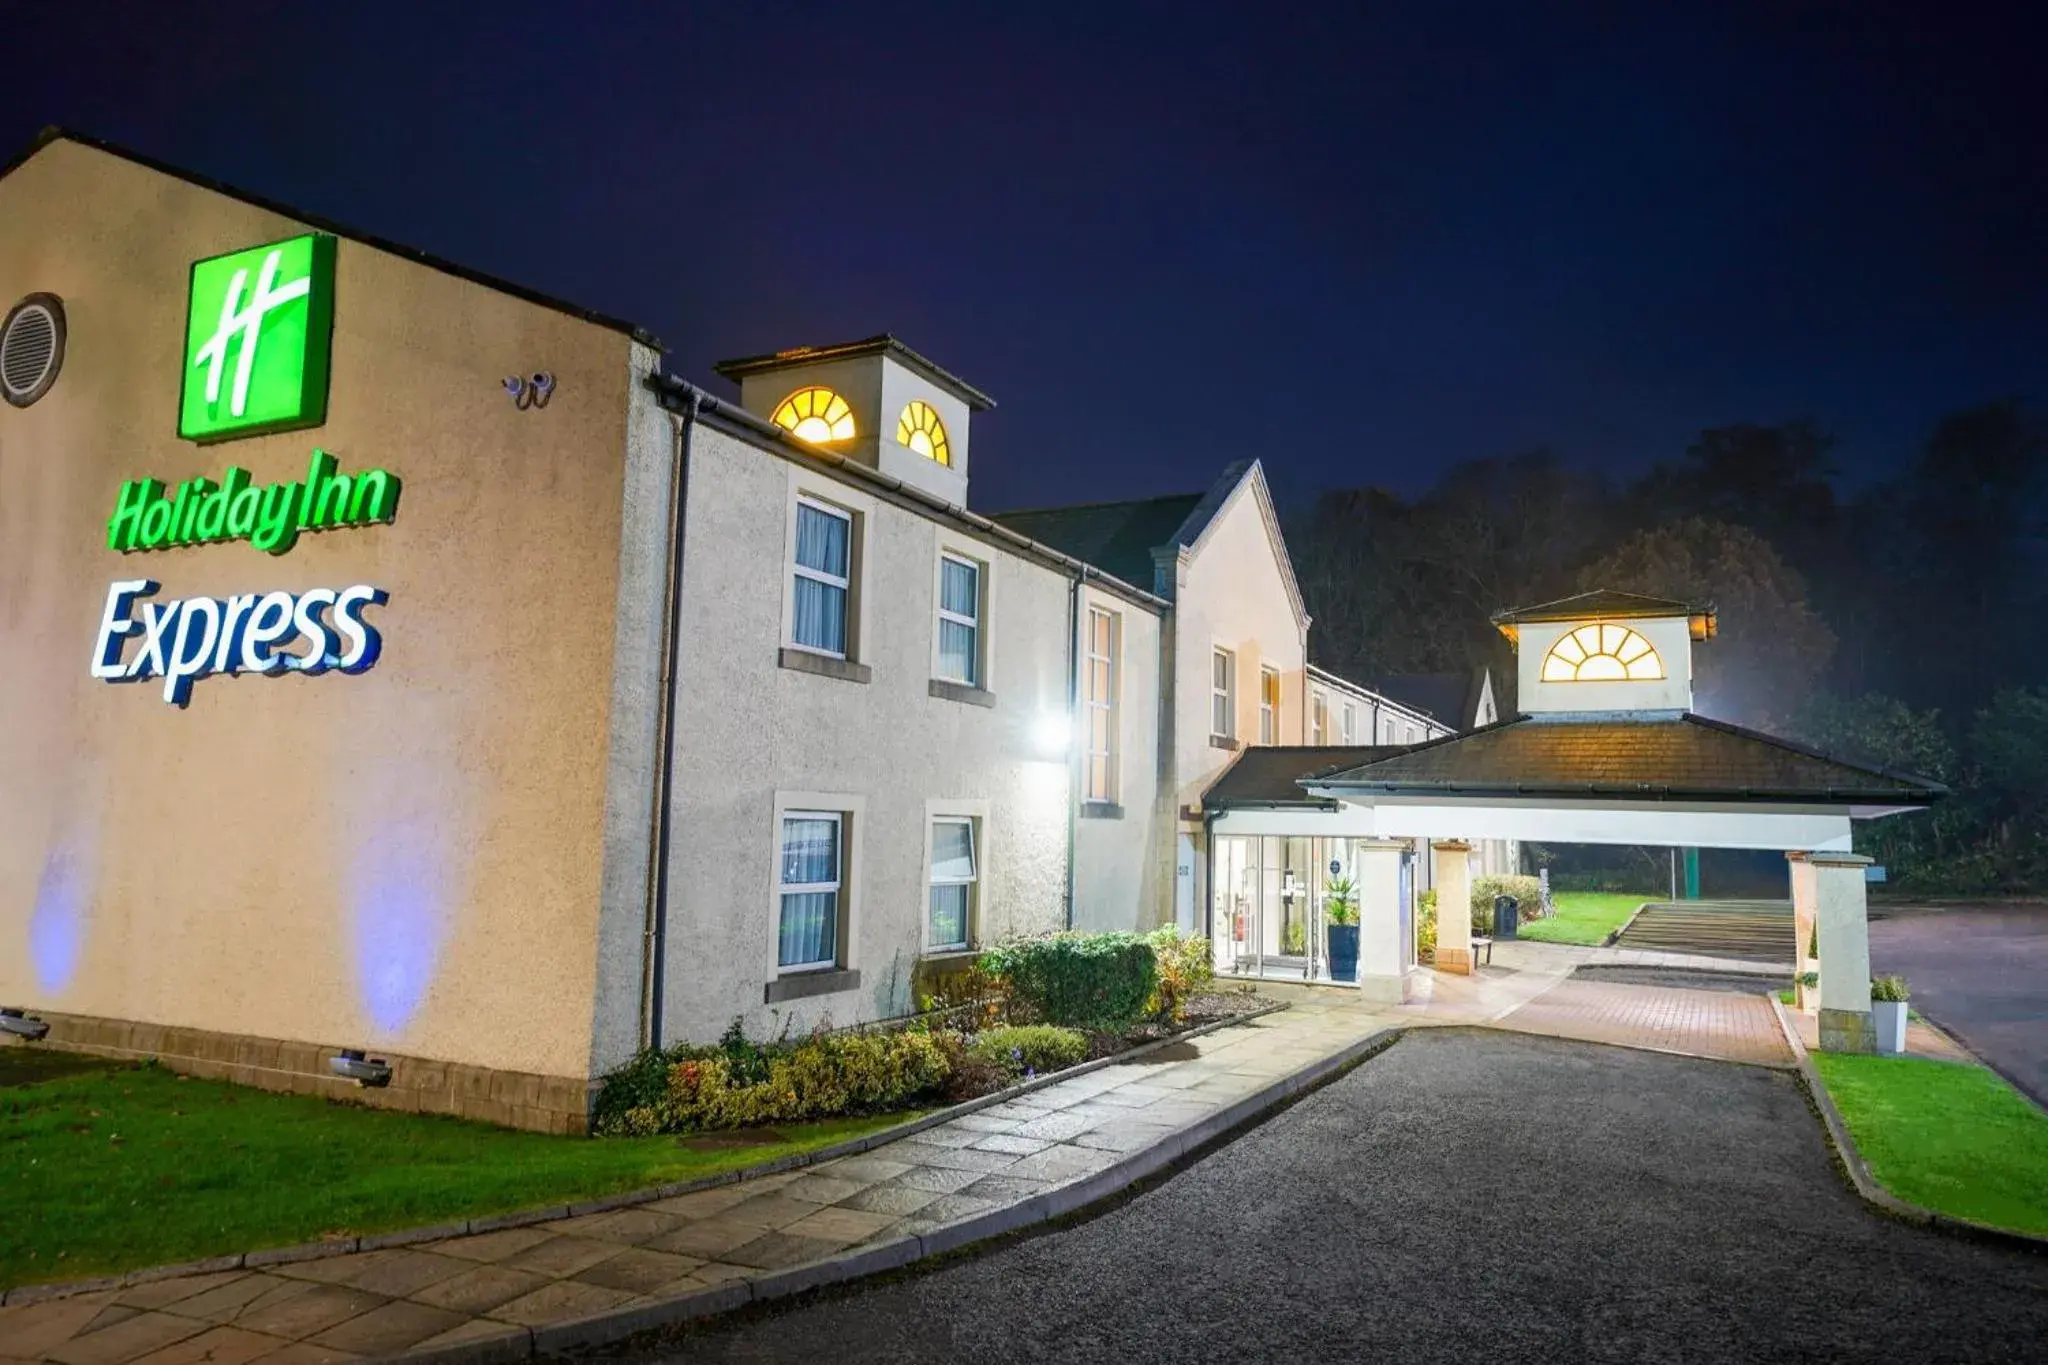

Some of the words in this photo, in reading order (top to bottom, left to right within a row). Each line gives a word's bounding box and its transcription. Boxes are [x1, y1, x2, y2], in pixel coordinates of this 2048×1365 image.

[107, 465, 303, 554] Holiday
[299, 447, 401, 530] Inn
[91, 578, 388, 706] Express
